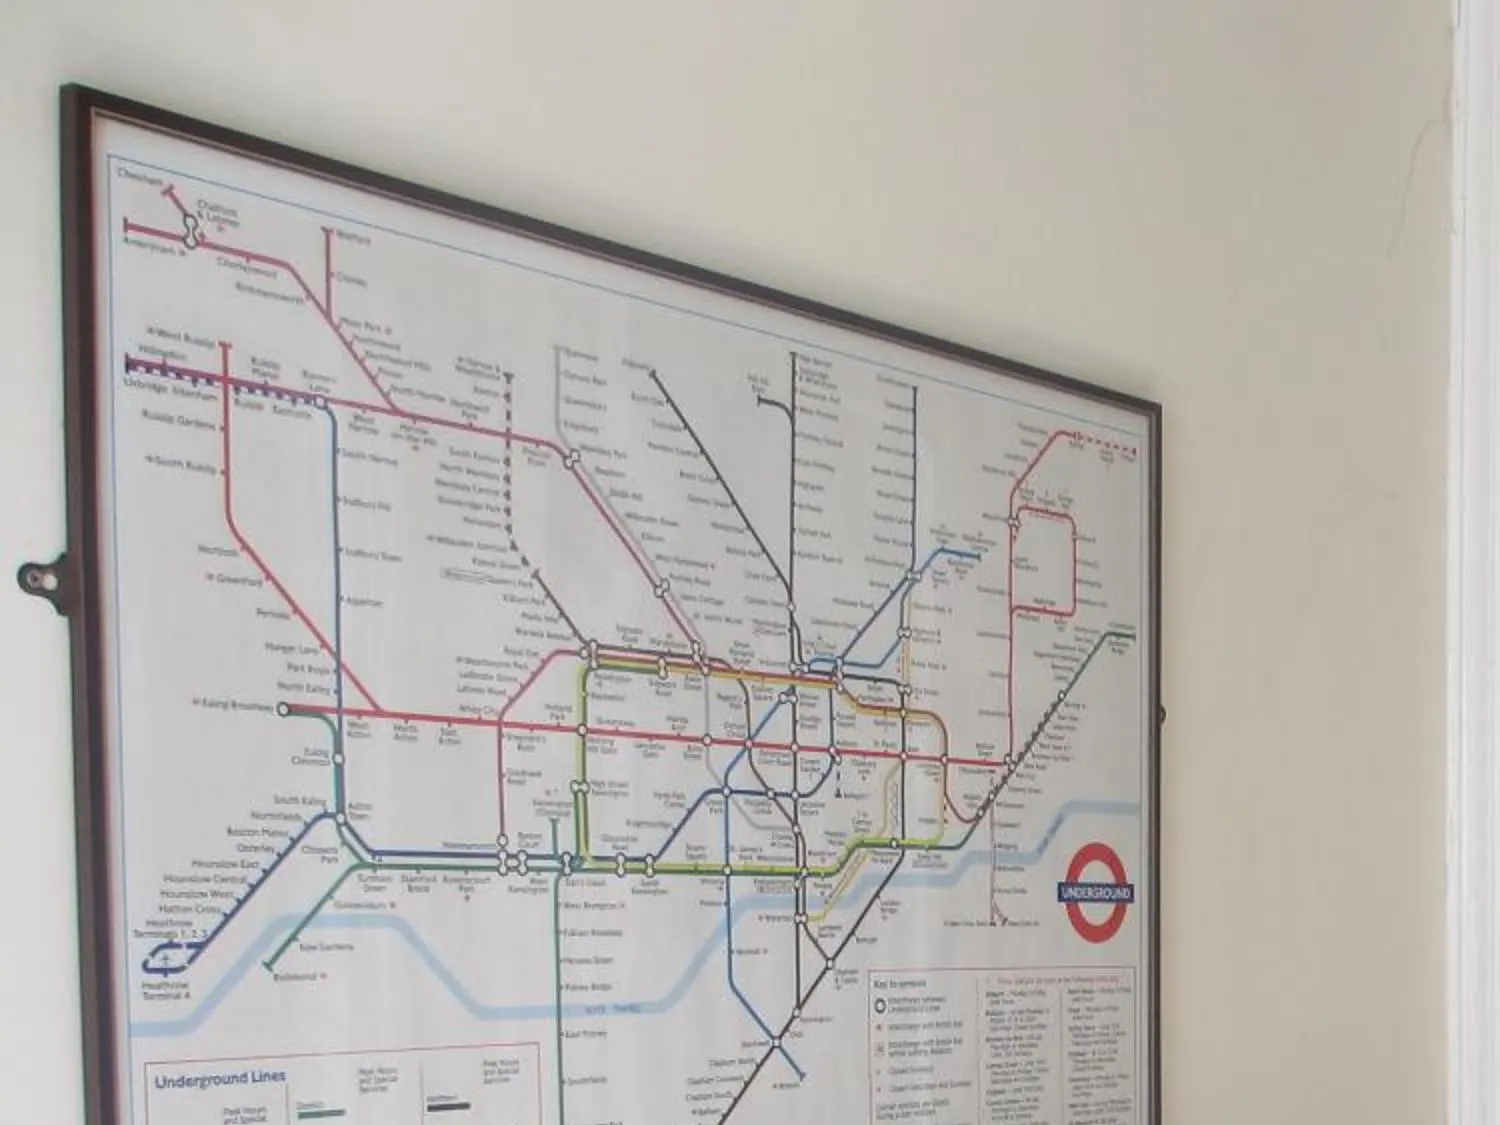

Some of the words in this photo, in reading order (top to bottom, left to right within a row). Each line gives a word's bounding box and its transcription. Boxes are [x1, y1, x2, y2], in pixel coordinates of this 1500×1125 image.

[1061, 886, 1132, 900] UNDERGROUND
[155, 1072, 249, 1090] Underground
[251, 1070, 287, 1084] Lines
